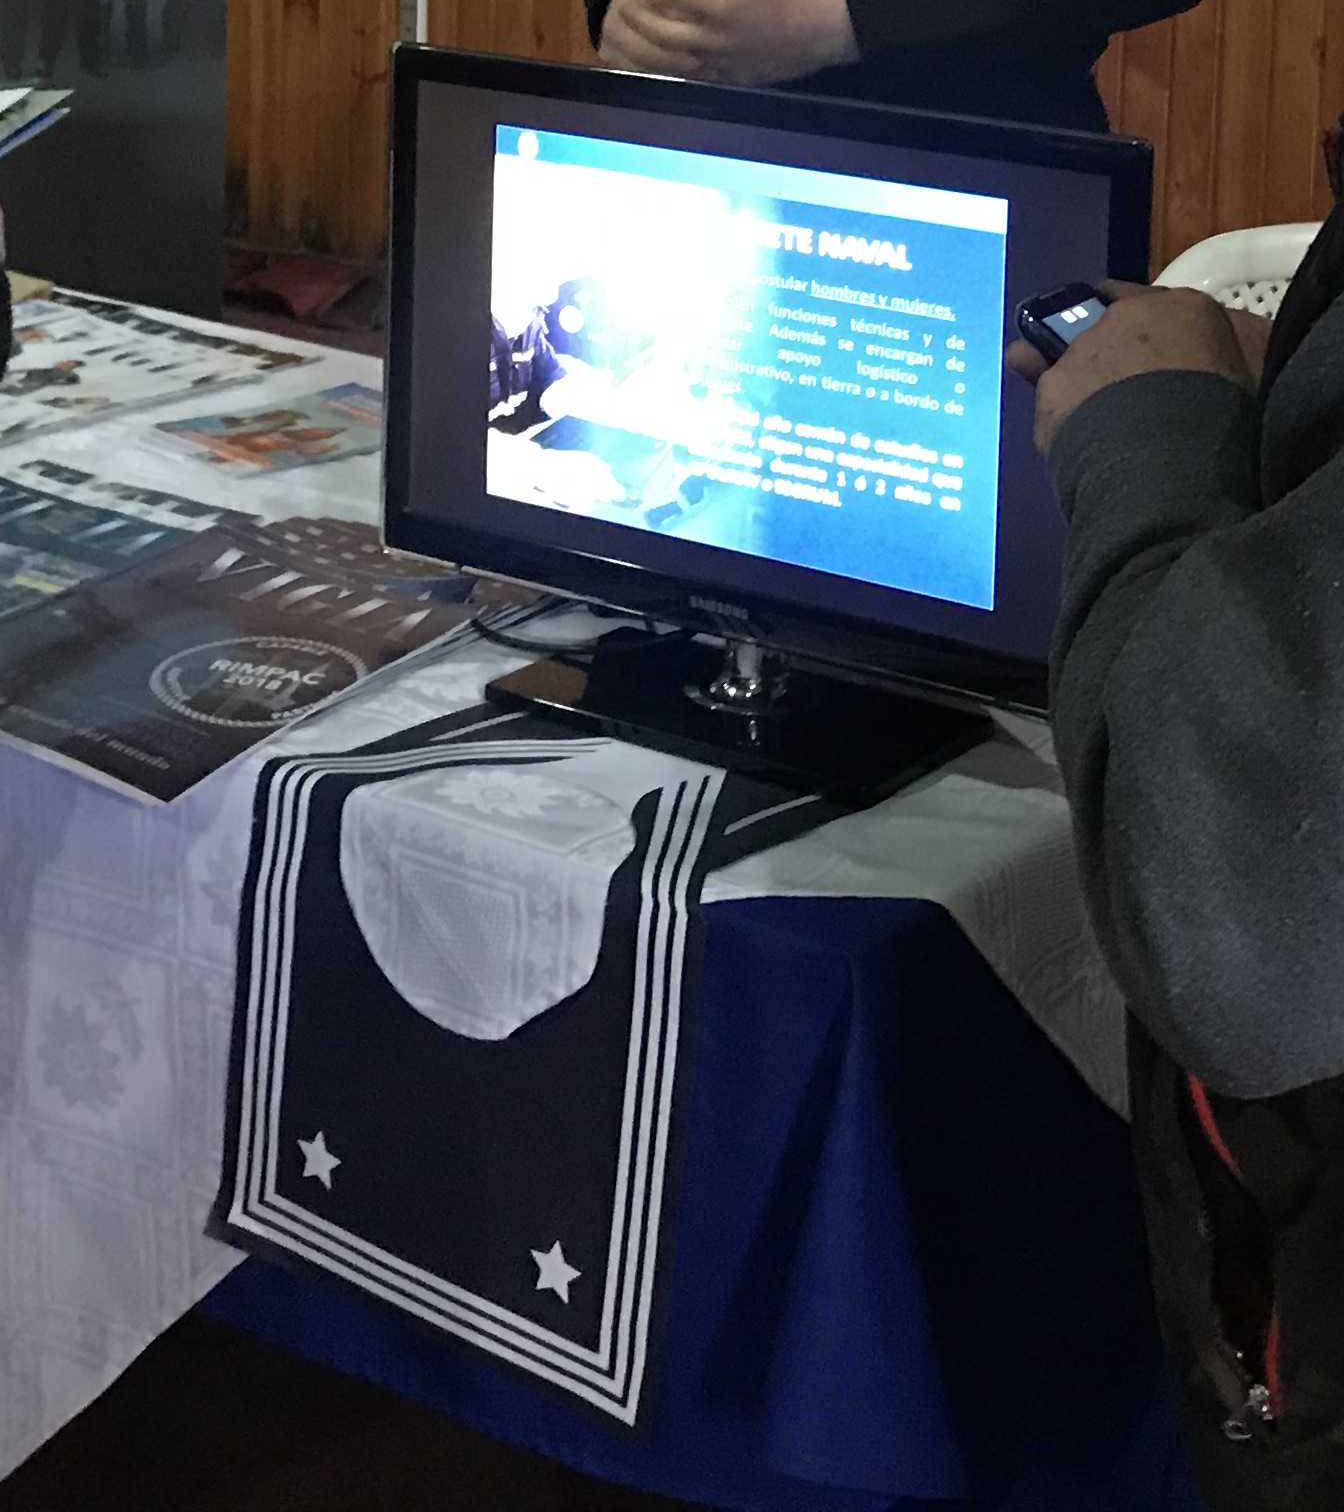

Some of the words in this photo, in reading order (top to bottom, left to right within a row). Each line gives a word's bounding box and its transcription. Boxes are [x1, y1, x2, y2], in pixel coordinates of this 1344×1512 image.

[811, 279, 876, 306] hombres
[768, 301, 837, 328] funciones
[850, 318, 911, 342] técnicas
[923, 332, 933, 347] y
[946, 334, 966, 351] de
[768, 323, 827, 347] Además
[837, 337, 855, 352] se
[865, 344, 934, 366] encargan
[946, 356, 966, 373] de
[776, 348, 822, 368] apoyo
[857, 360, 919, 386] logístico
[955, 382, 966, 394] o
[798, 373, 817, 387] en
[821, 375, 862, 396] tierra
[865, 387, 876, 399] o
[880, 389, 890, 401] a
[894, 389, 940, 411] bordo
[944, 399, 965, 416] de
[688, 593, 750, 621] SAMSUNG
[208, 658, 327, 687] RIMPAC
